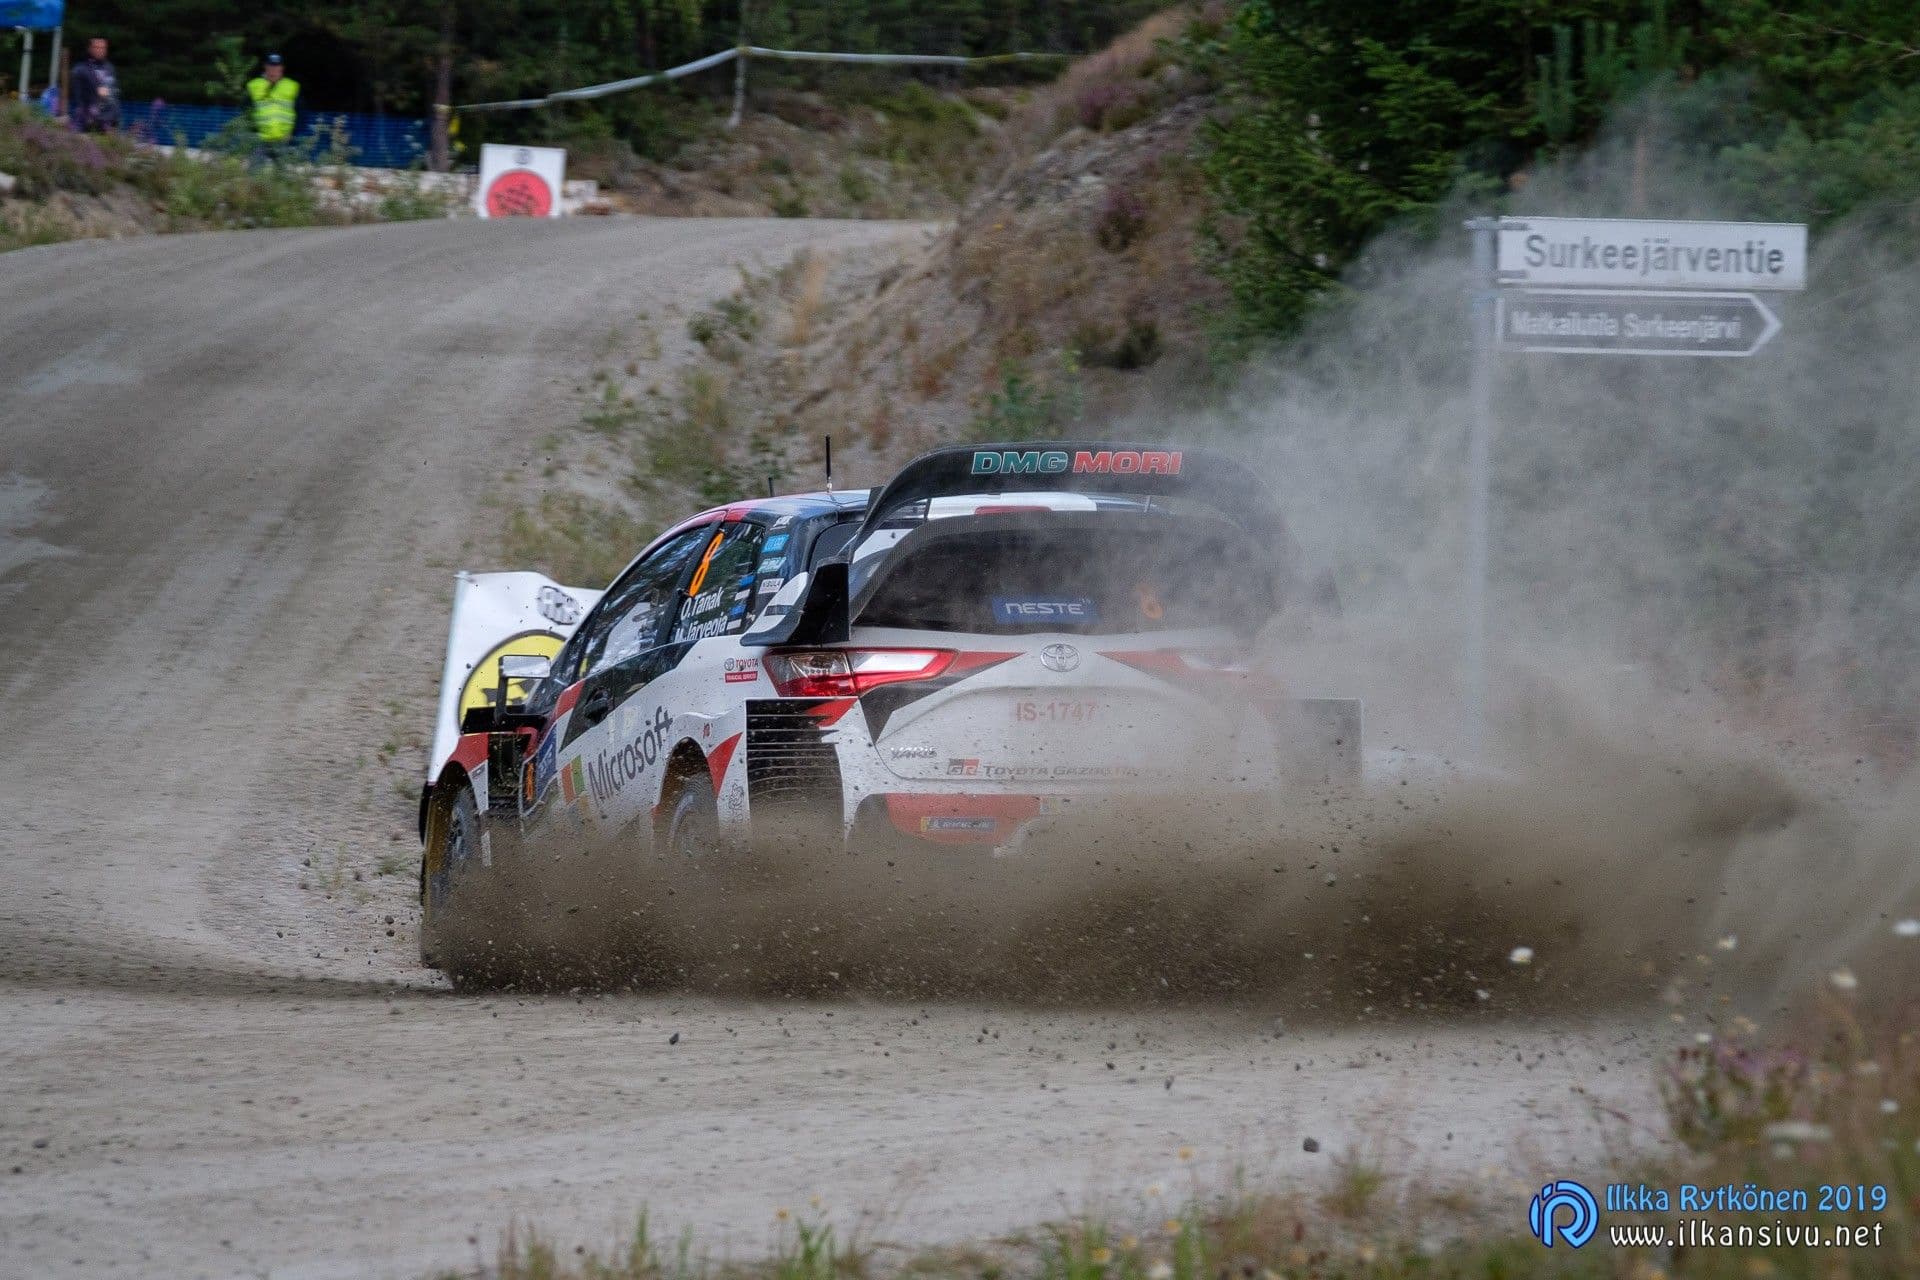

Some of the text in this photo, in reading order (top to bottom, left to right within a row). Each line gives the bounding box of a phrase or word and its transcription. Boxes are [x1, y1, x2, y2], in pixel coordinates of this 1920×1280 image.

[1525, 234, 1785, 276] Surkeejärventie
[971, 451, 1183, 474] DMG MORI
[1005, 602, 1084, 615] NESTE
[735, 657, 759, 670] TOYOTA
[588, 706, 673, 808] Microsoft
[983, 765, 1048, 776] TOYOTA
